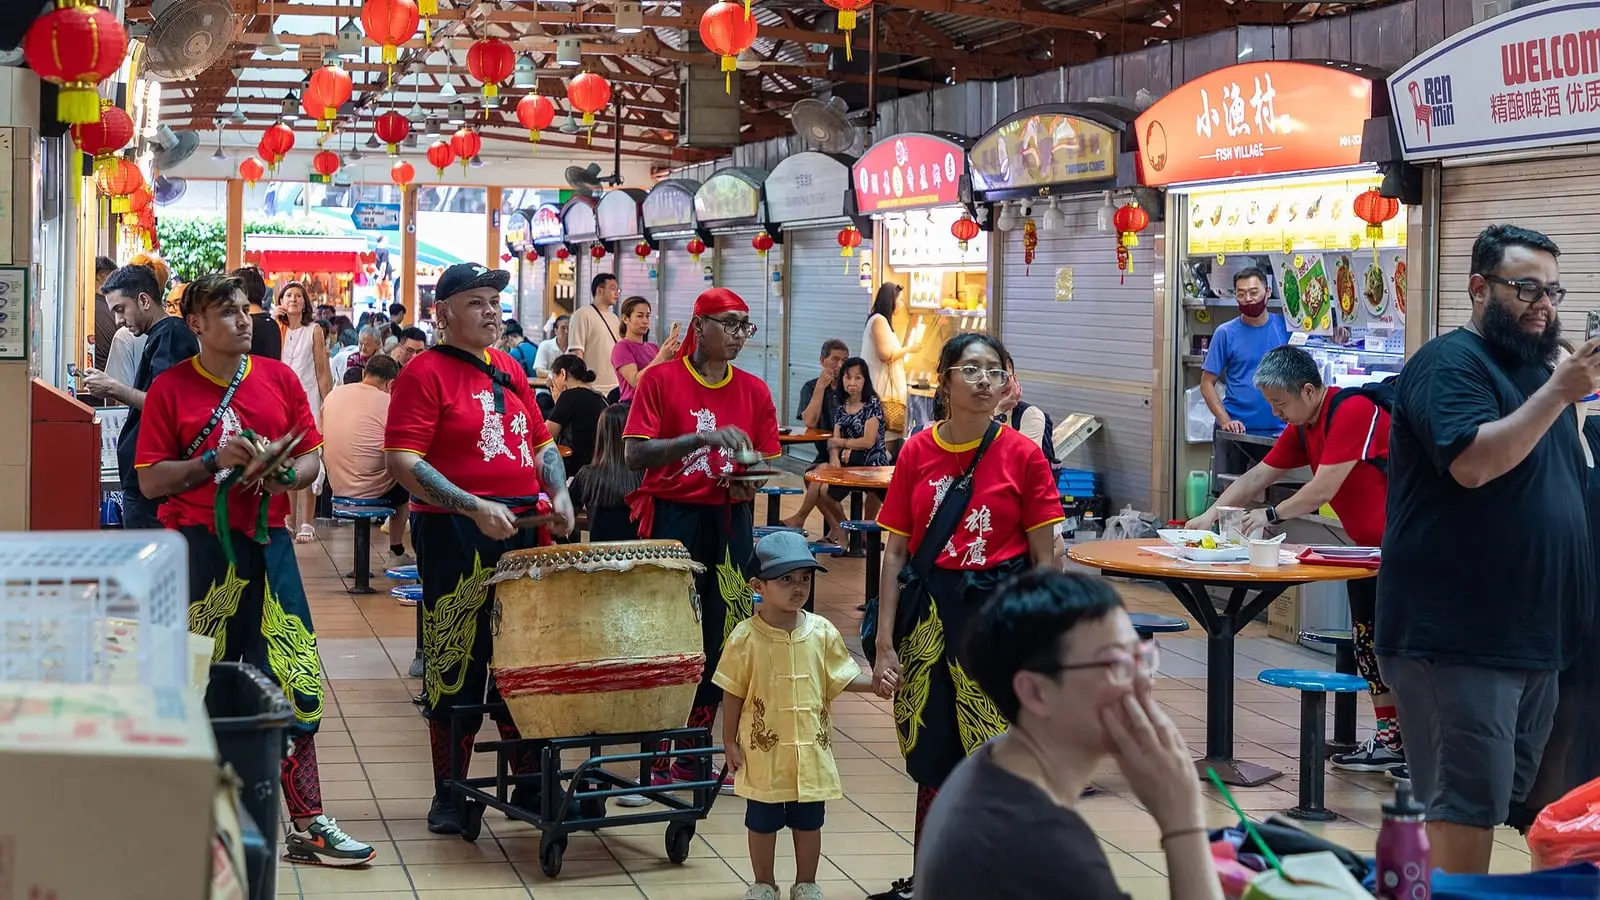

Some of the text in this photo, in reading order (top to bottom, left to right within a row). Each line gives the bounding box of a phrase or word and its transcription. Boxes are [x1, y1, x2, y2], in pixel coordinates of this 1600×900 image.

[1424, 74, 1453, 105] Ren
[1490, 80, 1600, 124] 精酿啤酒 优质
[1431, 103, 1455, 127] min
[1215, 142, 1265, 162] FISH VILLAGE
[214, 406, 224, 419] APE
